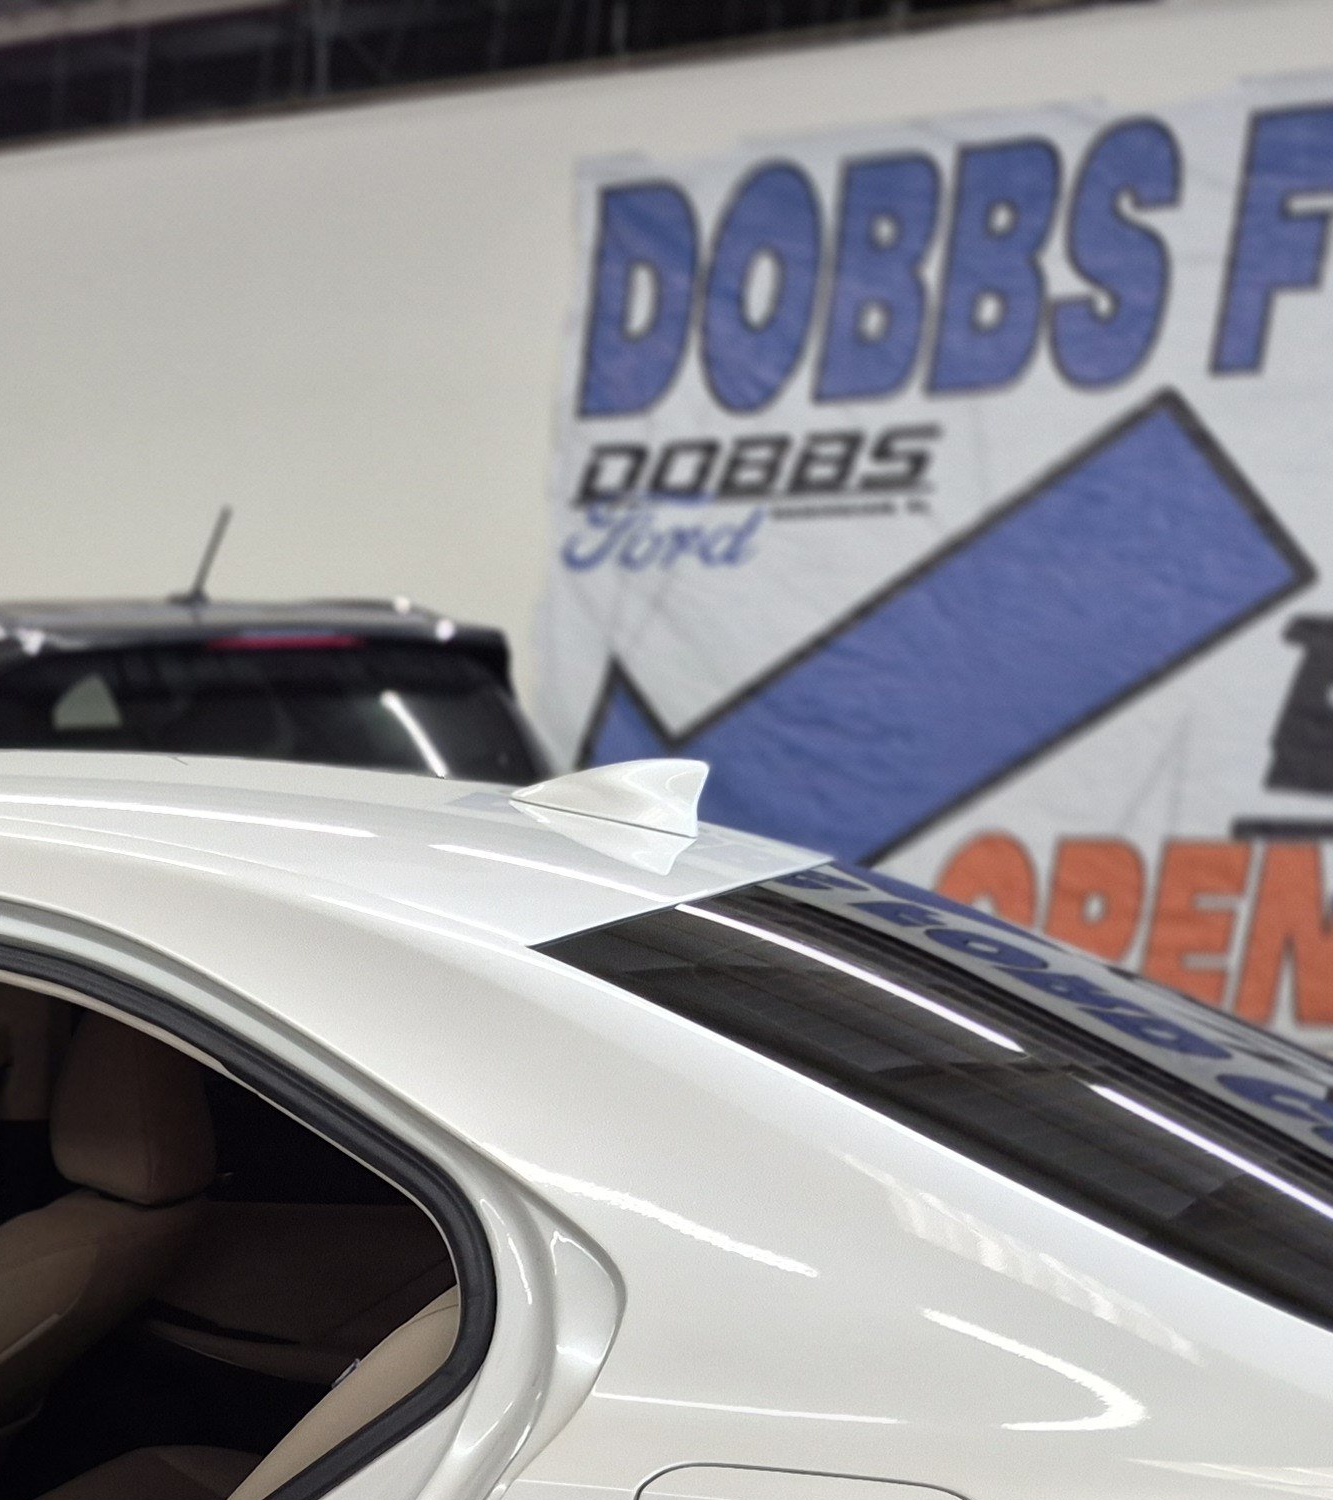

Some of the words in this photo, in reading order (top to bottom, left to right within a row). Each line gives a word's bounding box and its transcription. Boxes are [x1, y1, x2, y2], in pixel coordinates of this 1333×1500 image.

[575, 115, 1182, 418] DOBBS
[571, 422, 943, 508] DOBBS
[561, 490, 766, 571] Ford
